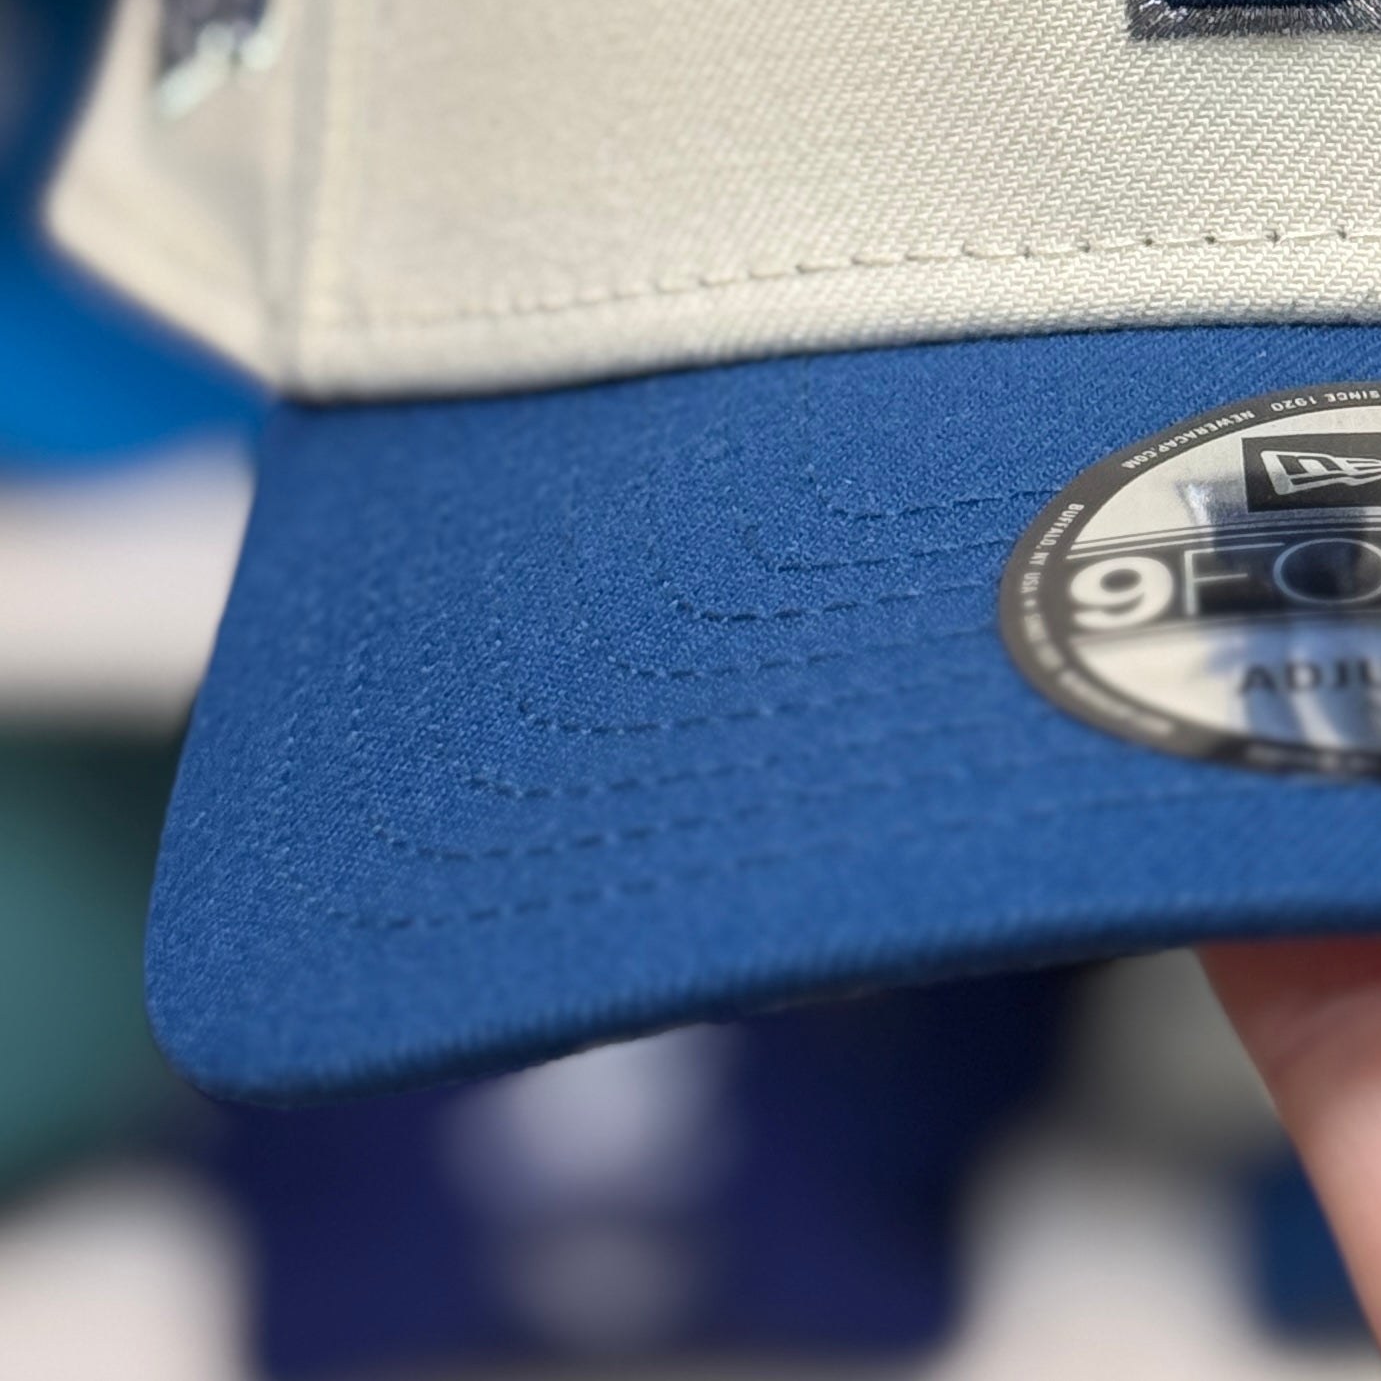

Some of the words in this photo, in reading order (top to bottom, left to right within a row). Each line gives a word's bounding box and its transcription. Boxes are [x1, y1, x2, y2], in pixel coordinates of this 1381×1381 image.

[1270, 393, 1317, 412] 1920
[1324, 390, 1380, 403] SINCE
[1121, 410, 1255, 469] NEWERACAP.COM
